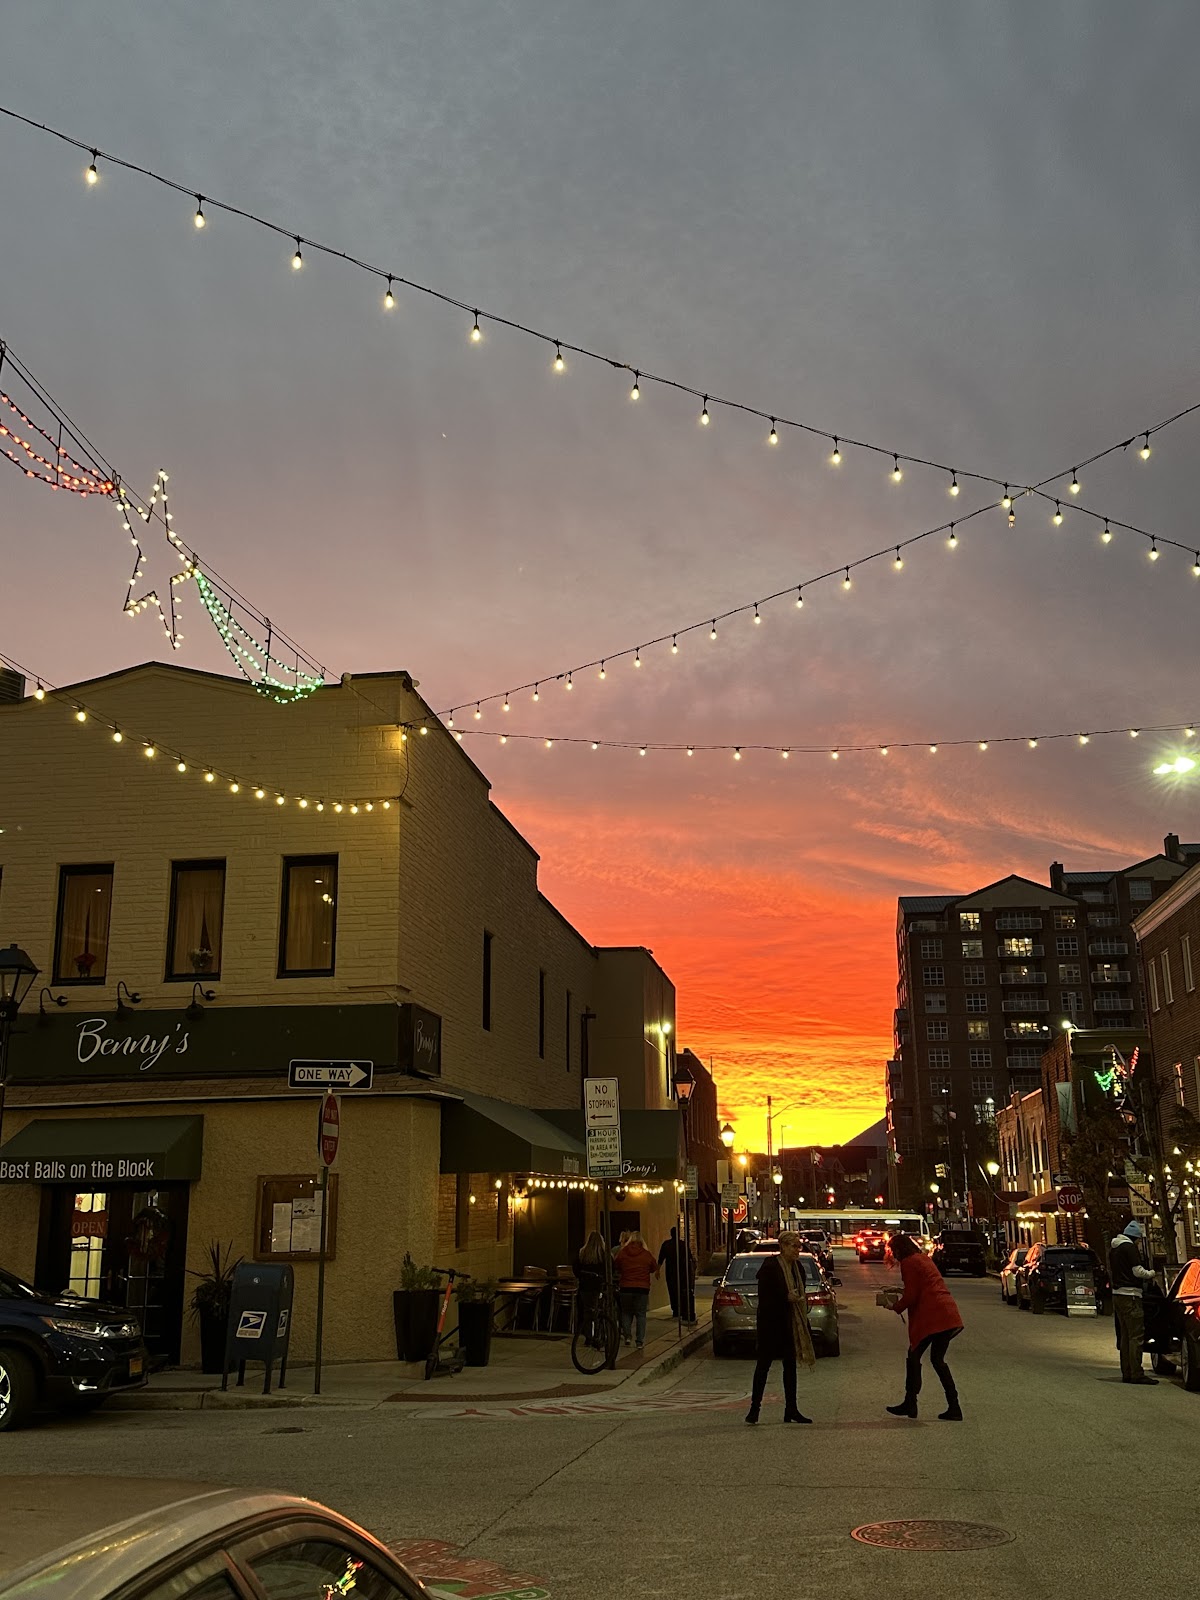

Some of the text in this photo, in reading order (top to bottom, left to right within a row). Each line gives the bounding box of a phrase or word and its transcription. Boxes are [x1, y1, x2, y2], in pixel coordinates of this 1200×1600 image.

[76, 1018, 190, 1071] Benny's
[416, 1019, 438, 1064] Benny's
[298, 1069, 353, 1080] ONE WAY
[595, 1084, 608, 1095] NO
[588, 1099, 616, 1109] STOPPING
[0, 1159, 155, 1179] Best Balls on the Block
[1058, 1194, 1083, 1205] STOP
[723, 1204, 746, 1215] SOP
[72, 1221, 105, 1235] OPEN
